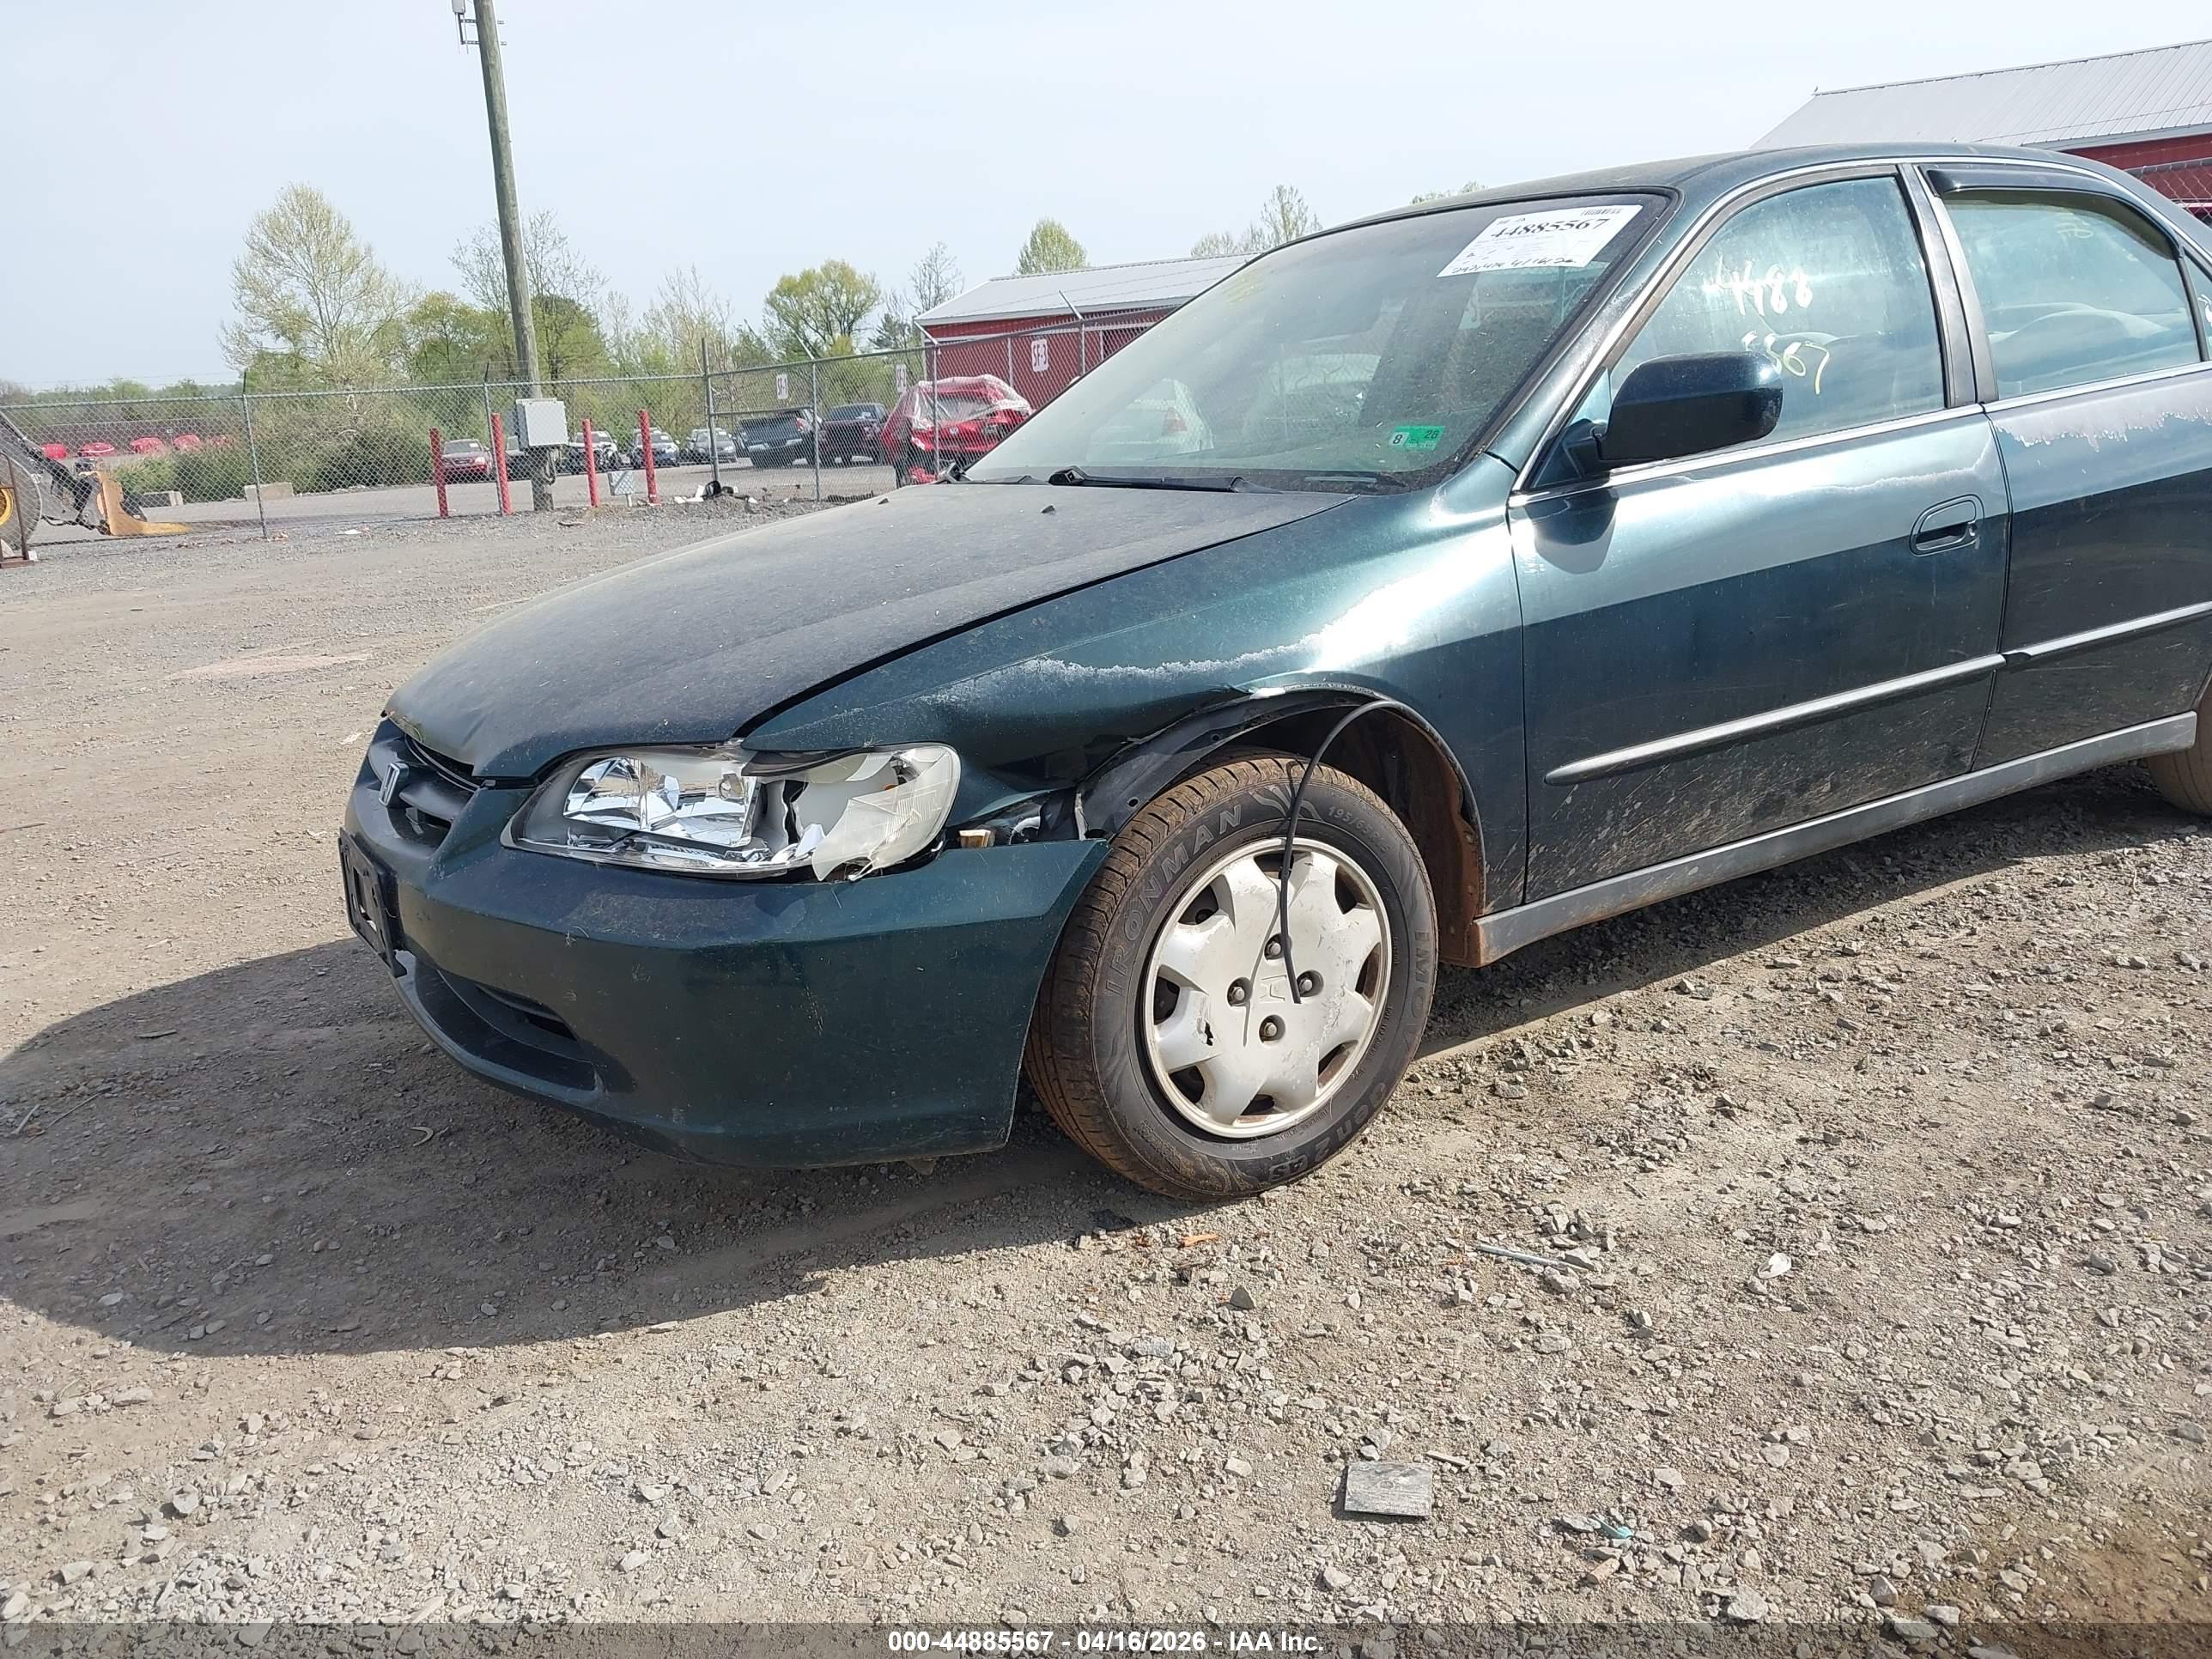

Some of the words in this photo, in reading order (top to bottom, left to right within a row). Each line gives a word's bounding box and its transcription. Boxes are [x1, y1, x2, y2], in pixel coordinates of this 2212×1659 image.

[1490, 218, 1610, 238] 44885567
[1393, 434, 1403, 445] 8
[1424, 429, 1439, 439] 26
[1106, 804, 1242, 996] IRONMAN
